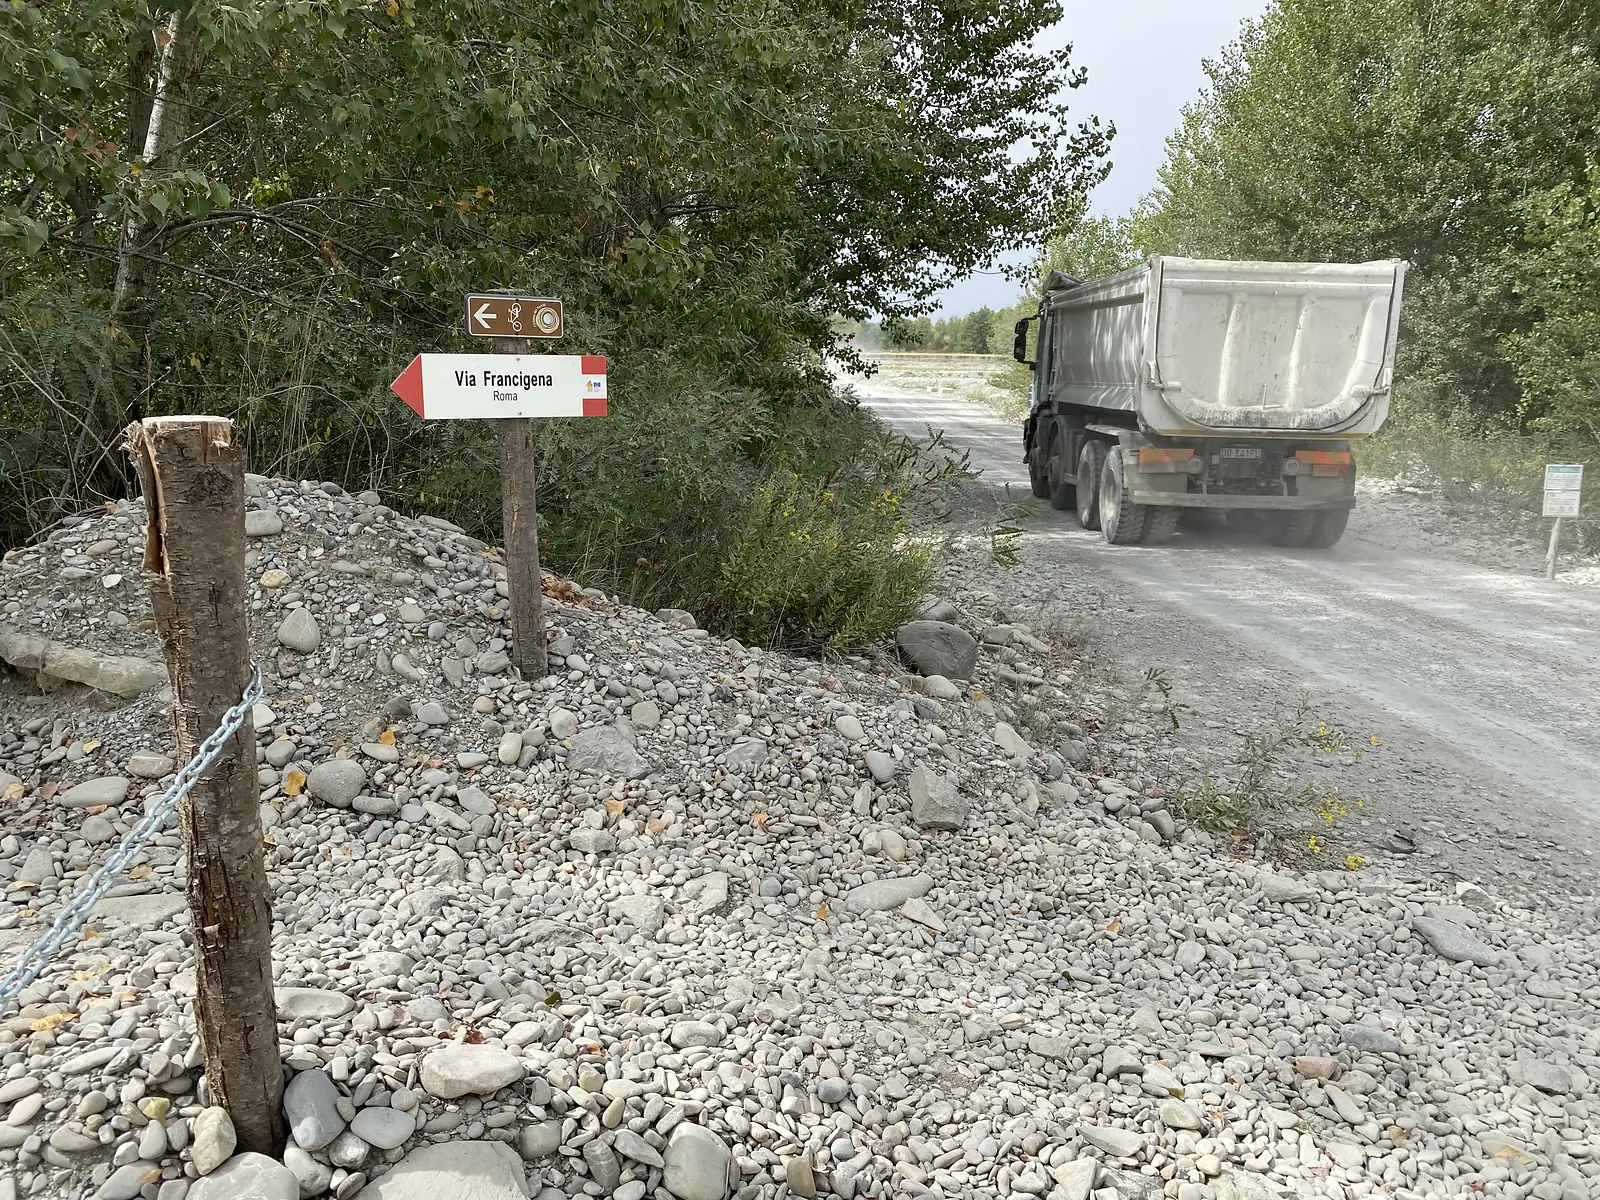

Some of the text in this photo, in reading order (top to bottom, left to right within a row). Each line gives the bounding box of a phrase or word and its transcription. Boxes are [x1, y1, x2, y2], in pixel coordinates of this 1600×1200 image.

[455, 370, 553, 391] Via Francigena
[493, 390, 518, 402] Roma
